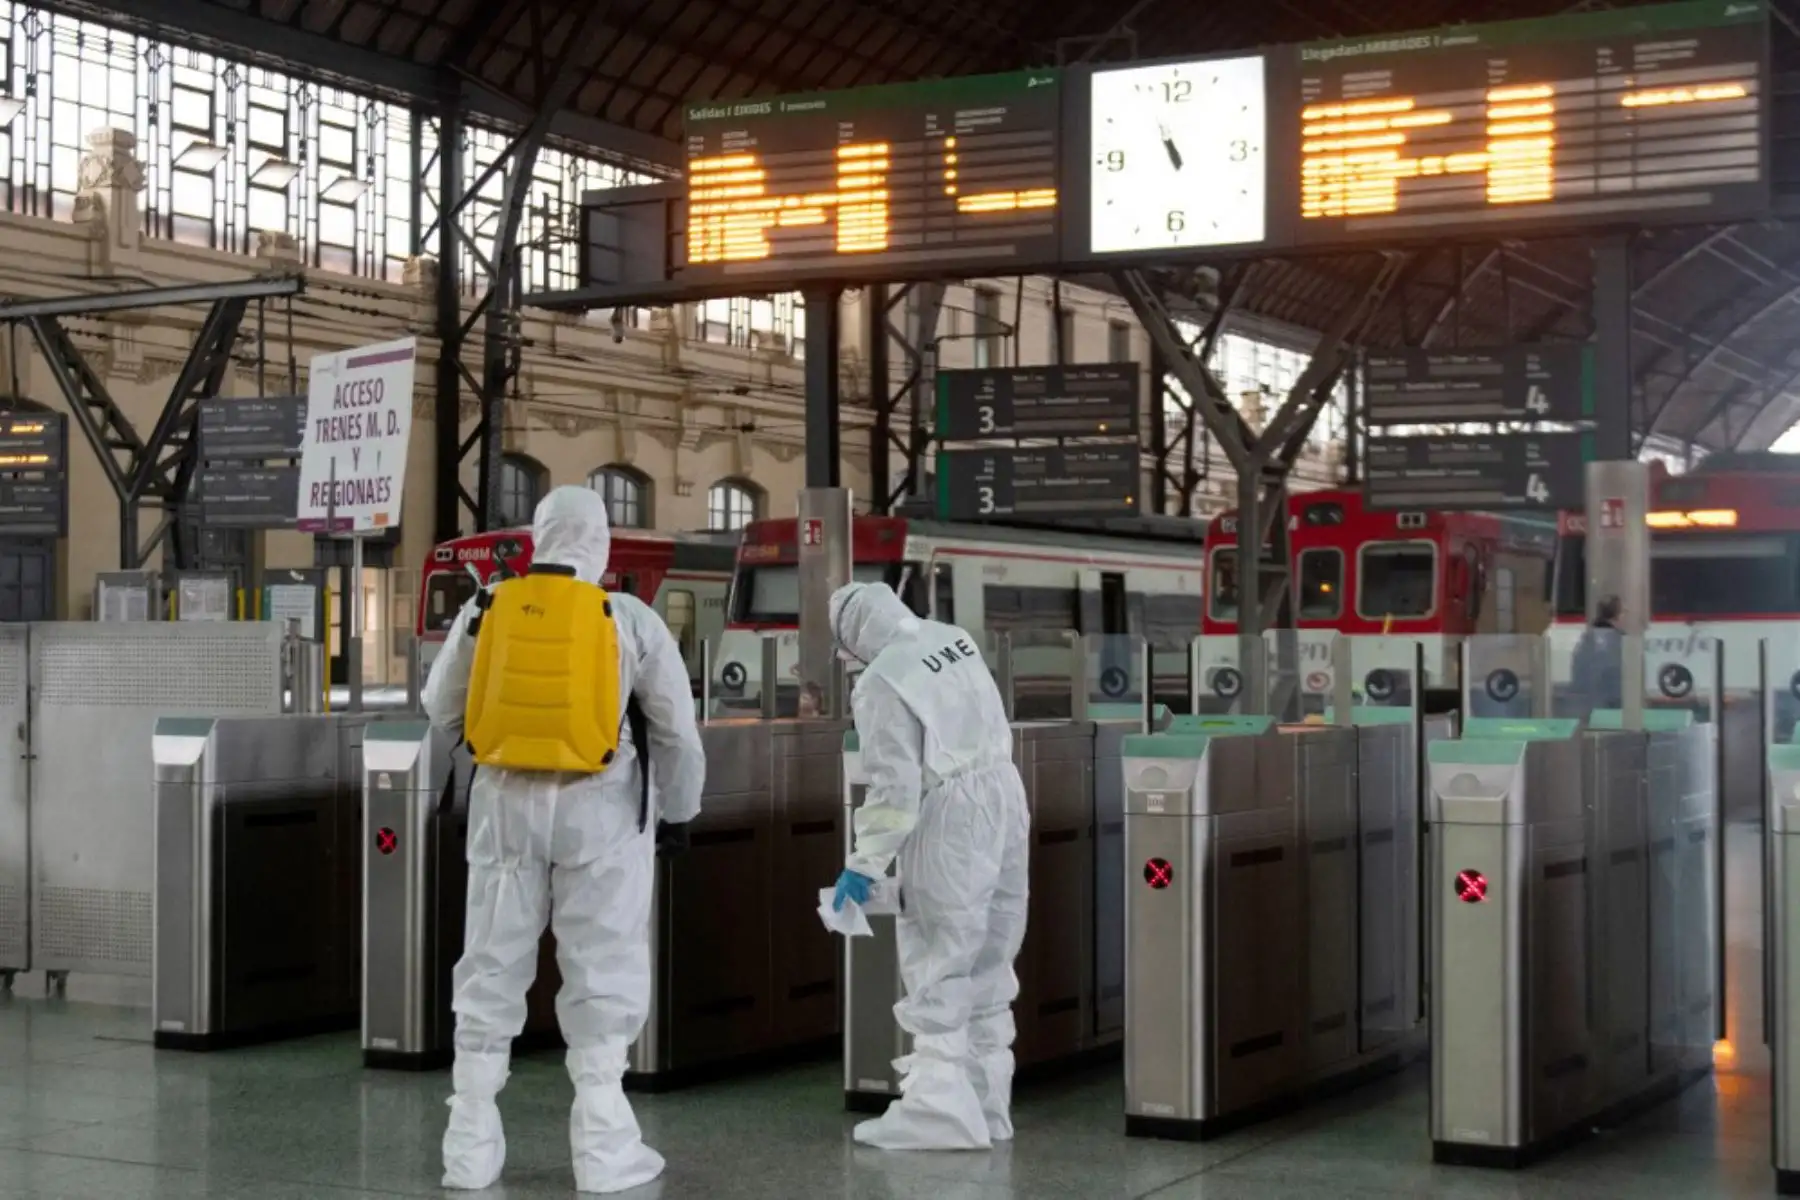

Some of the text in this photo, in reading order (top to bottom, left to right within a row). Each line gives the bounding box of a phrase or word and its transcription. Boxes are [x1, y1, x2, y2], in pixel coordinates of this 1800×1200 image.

[1160, 79, 1193, 103] 12
[1106, 149, 1125, 172] 9
[1229, 139, 1248, 162] 3
[1166, 209, 1185, 232] 6
[333, 377, 384, 410] ACCESO
[1525, 384, 1550, 415] 4
[315, 412, 362, 444] TRENES
[386, 409, 400, 436] D.
[978, 405, 995, 434] 3
[352, 446, 360, 472] Y
[310, 475, 392, 508] REGIONAES
[978, 486, 995, 514] 3
[1525, 472, 1550, 503] 4
[921, 638, 975, 673] UME
